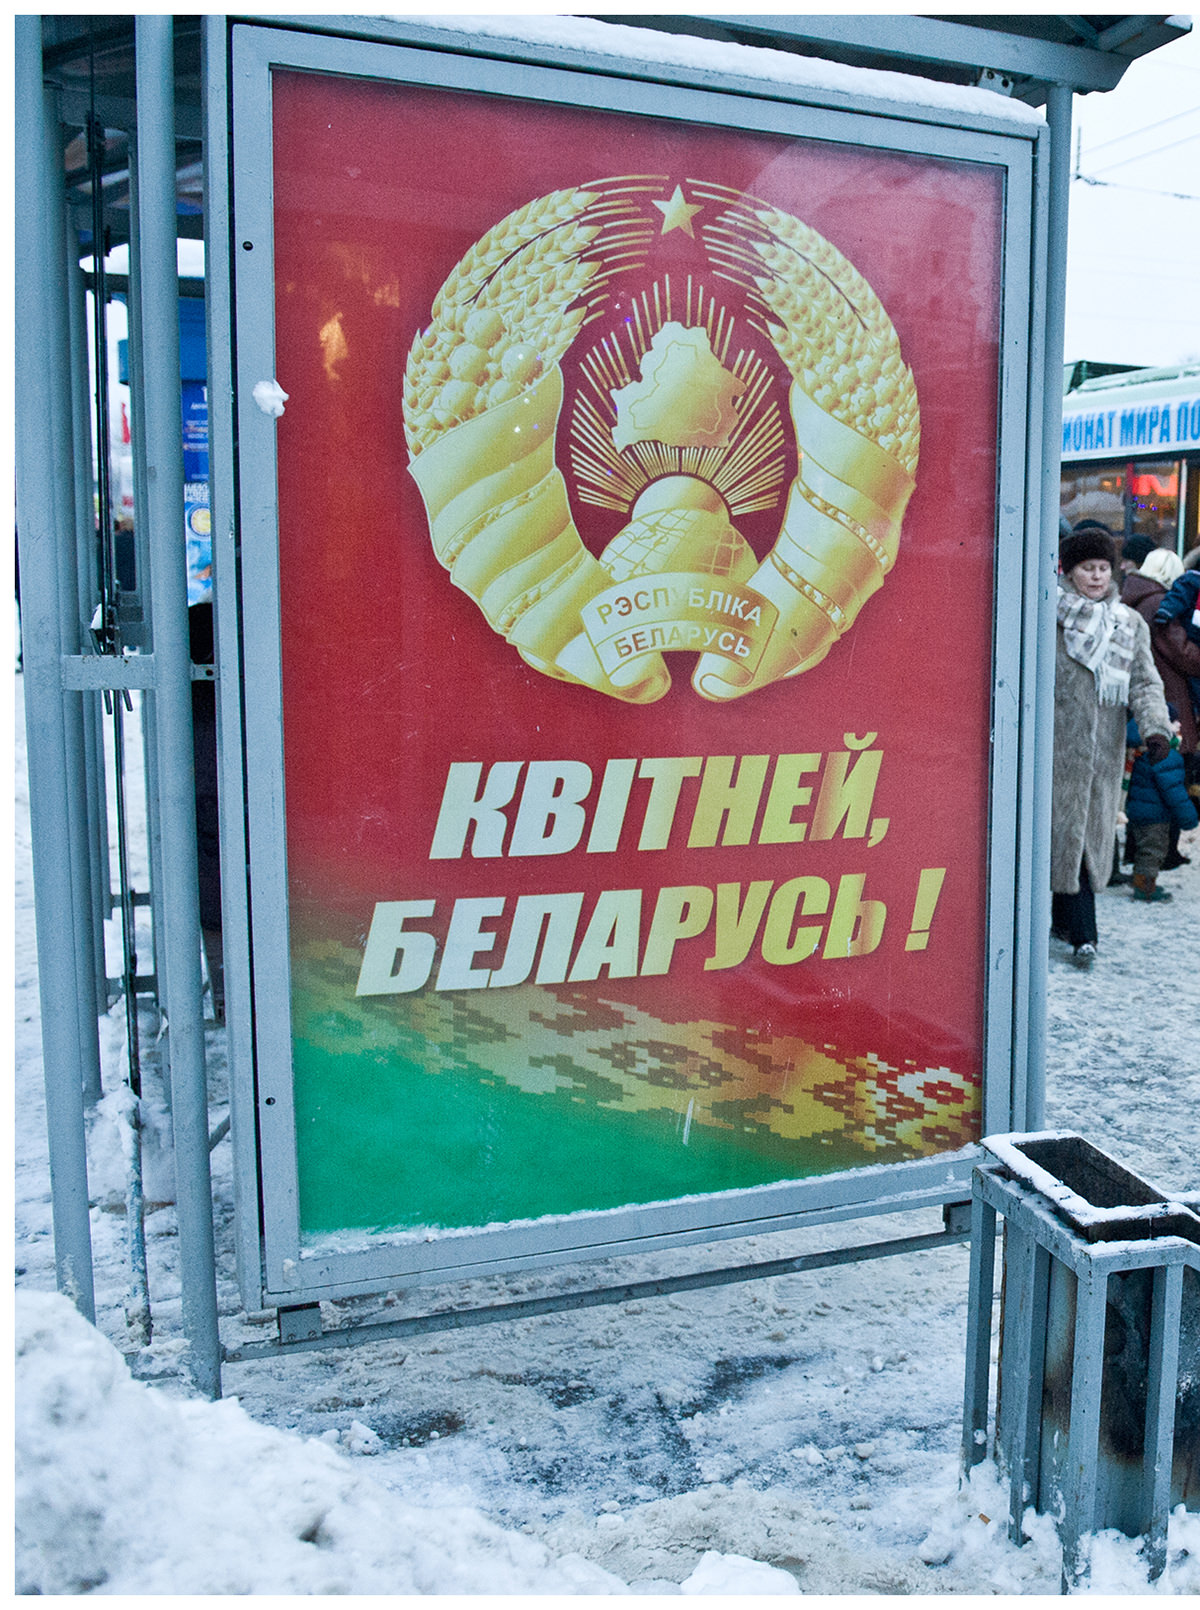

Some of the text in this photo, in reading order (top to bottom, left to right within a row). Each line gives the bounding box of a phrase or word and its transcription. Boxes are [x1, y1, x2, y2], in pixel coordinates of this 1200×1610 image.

[1119, 402, 1172, 447] МИРА
[596, 587, 762, 627] РЭСПУБЛІКА
[614, 625, 751, 658] БЕЛАРУСЬ
[429, 732, 890, 860] КВІТНЕЙ,
[355, 867, 947, 997] БЕЛАРУСЬ !
